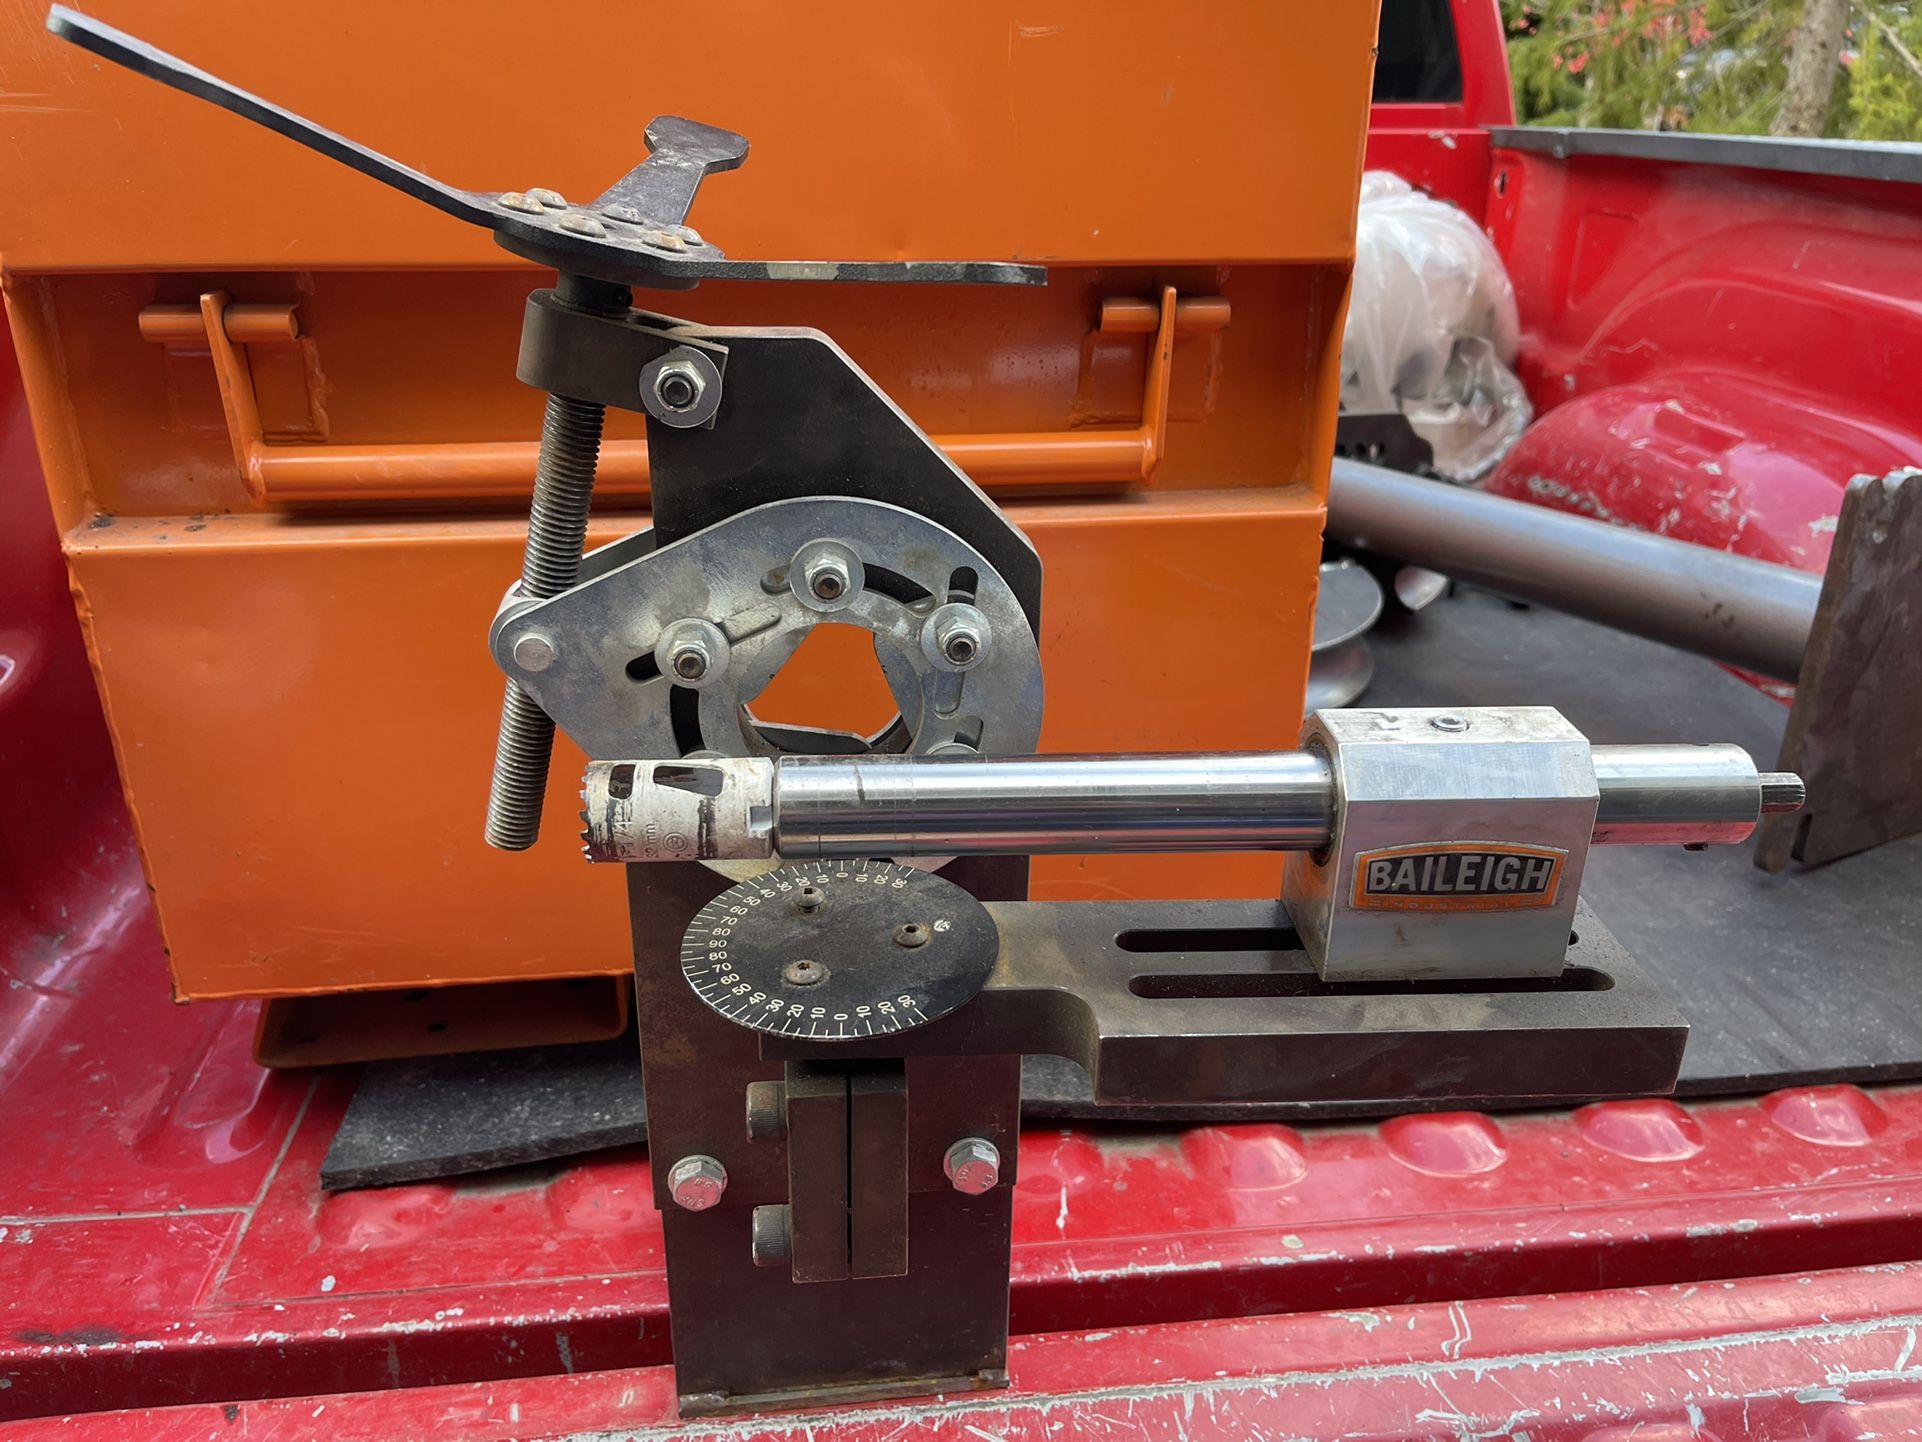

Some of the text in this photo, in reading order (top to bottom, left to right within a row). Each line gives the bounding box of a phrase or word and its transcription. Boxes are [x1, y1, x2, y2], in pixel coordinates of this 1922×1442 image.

[1369, 855, 1551, 892] BAILEIGH
[761, 888, 775, 898] 40
[743, 896, 760, 906] 50
[730, 906, 748, 915] 60
[720, 916, 738, 925] 70
[713, 927, 731, 936] 80
[709, 940, 727, 948] 90
[709, 951, 727, 960] 80
[712, 963, 731, 972] 70
[720, 973, 740, 985] 60
[732, 983, 752, 995] 50
[748, 992, 767, 1005] 40
[898, 994, 916, 1008] 30
[766, 999, 784, 1013] 30
[786, 1004, 804, 1018] 20
[856, 1005, 871, 1018] 10
[878, 1001, 896, 1014] 20
[810, 1007, 825, 1019] 10
